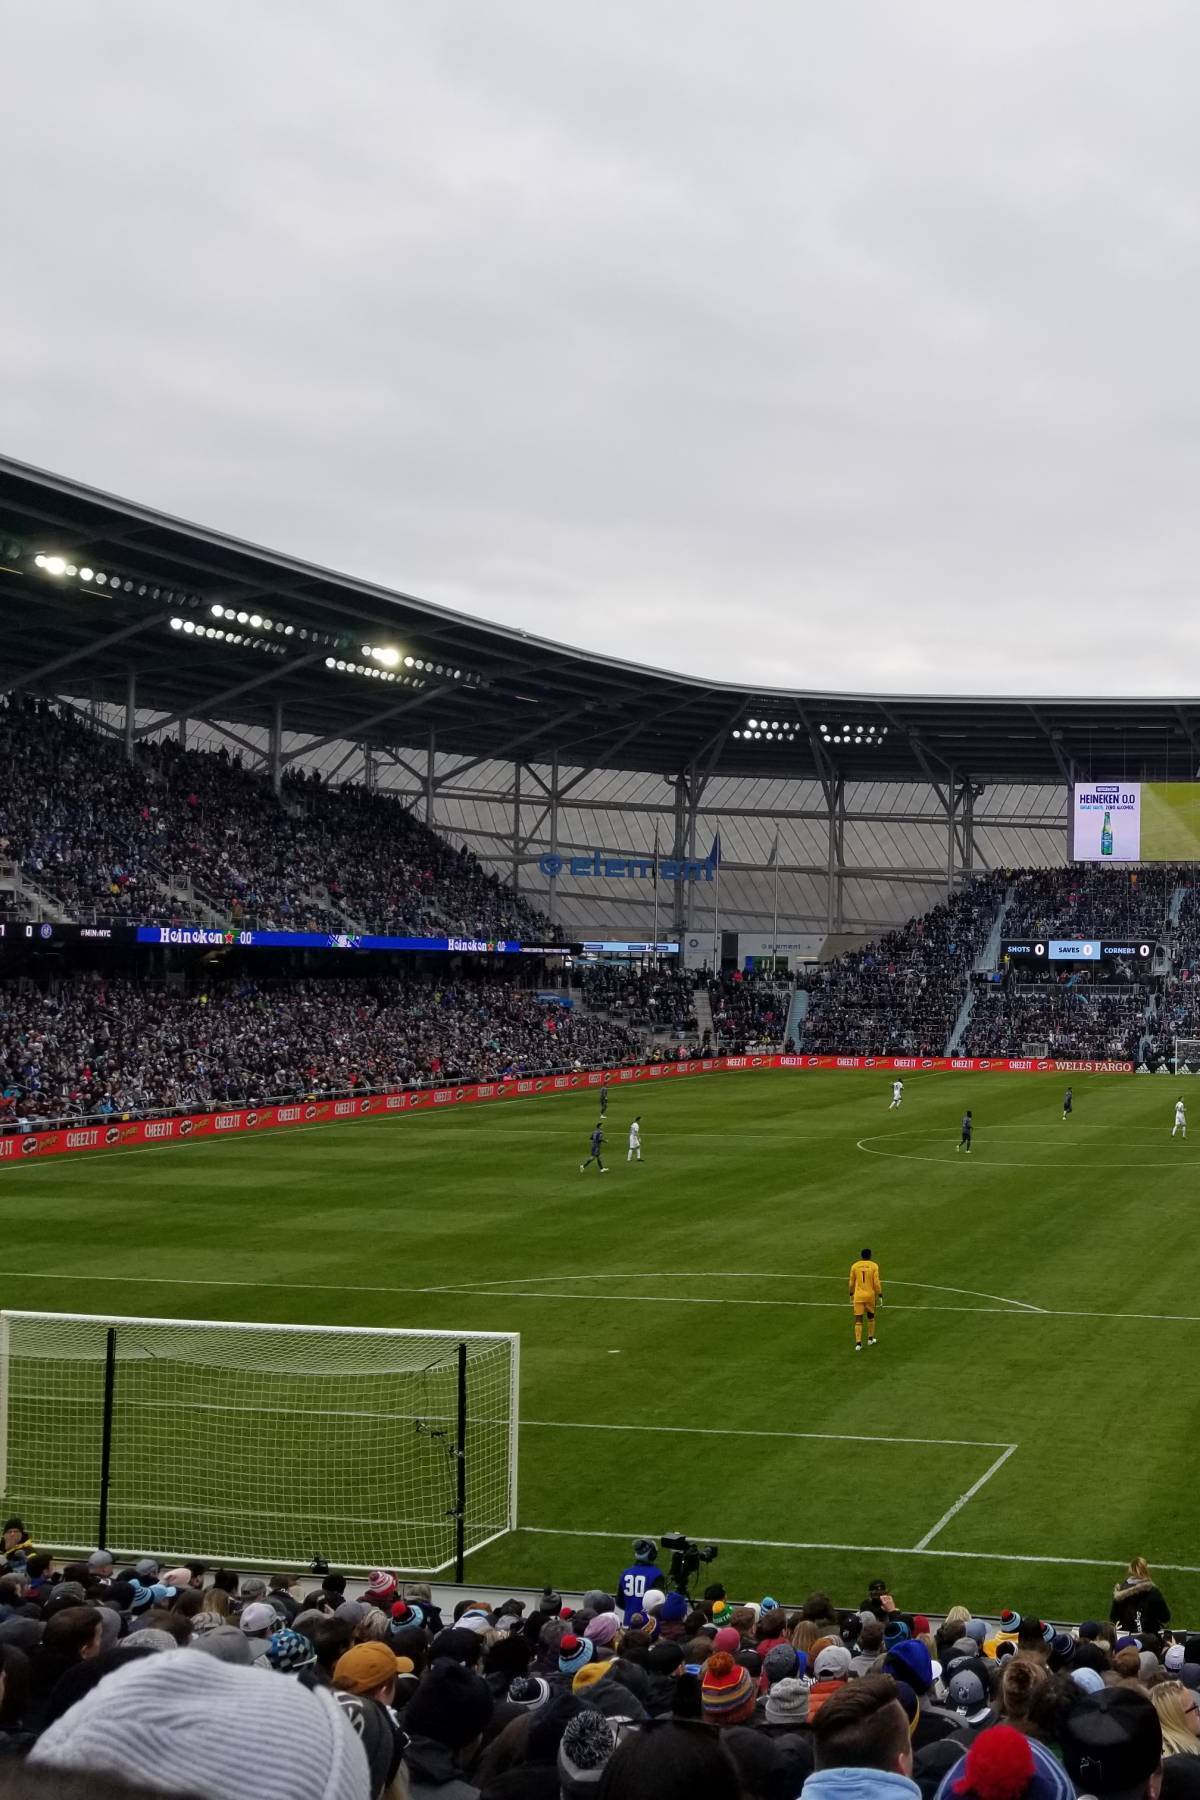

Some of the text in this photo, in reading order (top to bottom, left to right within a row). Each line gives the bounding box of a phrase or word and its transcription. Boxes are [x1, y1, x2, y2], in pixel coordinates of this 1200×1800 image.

[1080, 794, 1136, 804] HEINEKEN 0.0
[570, 851, 714, 881] element
[160, 927, 223, 943] Heineken
[447, 938, 487, 951] Heineken
[1034, 943, 1045, 955] 0
[1082, 944, 1093, 956] 0
[1139, 944, 1150, 956] 0
[1056, 1061, 1092, 1071] WELLS
[1094, 1062, 1132, 1072] FARGO
[624, 1574, 646, 1598] 30
